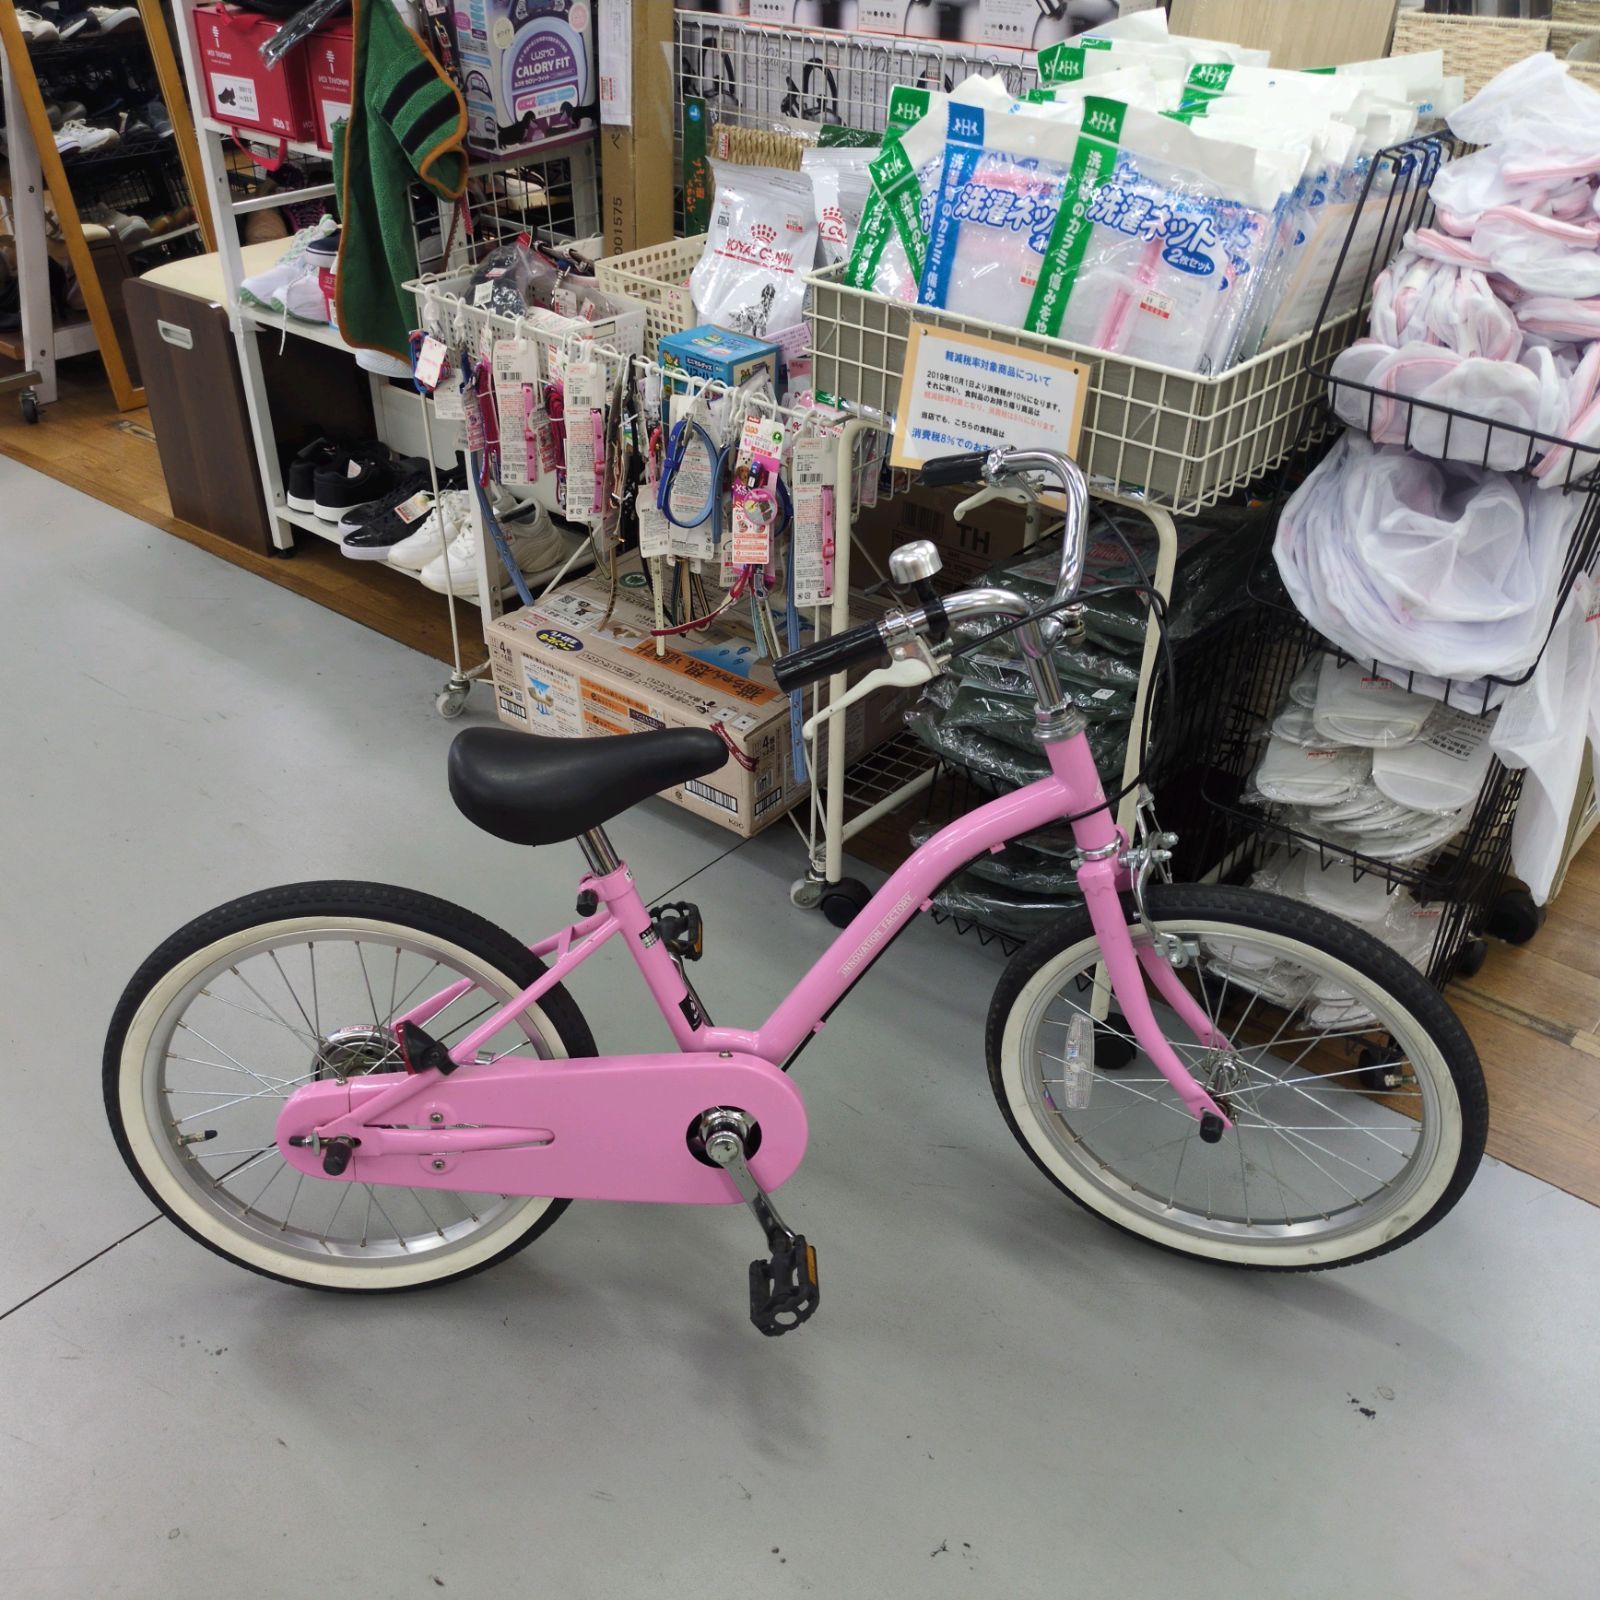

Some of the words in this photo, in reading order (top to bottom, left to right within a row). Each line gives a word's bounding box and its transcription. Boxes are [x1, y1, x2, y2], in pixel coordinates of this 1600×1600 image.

[515, 60, 554, 79] CALORY
[555, 56, 571, 70] FIT
[1085, 184, 1217, 247] 洗濯ネット
[1166, 249, 1213, 275] 2枚セット
[944, 350, 1052, 388] 軽減税率対象商品について
[921, 411, 1006, 439] 当店でも、こちらの食料品は
[840, 929, 883, 977] INNOVATION
